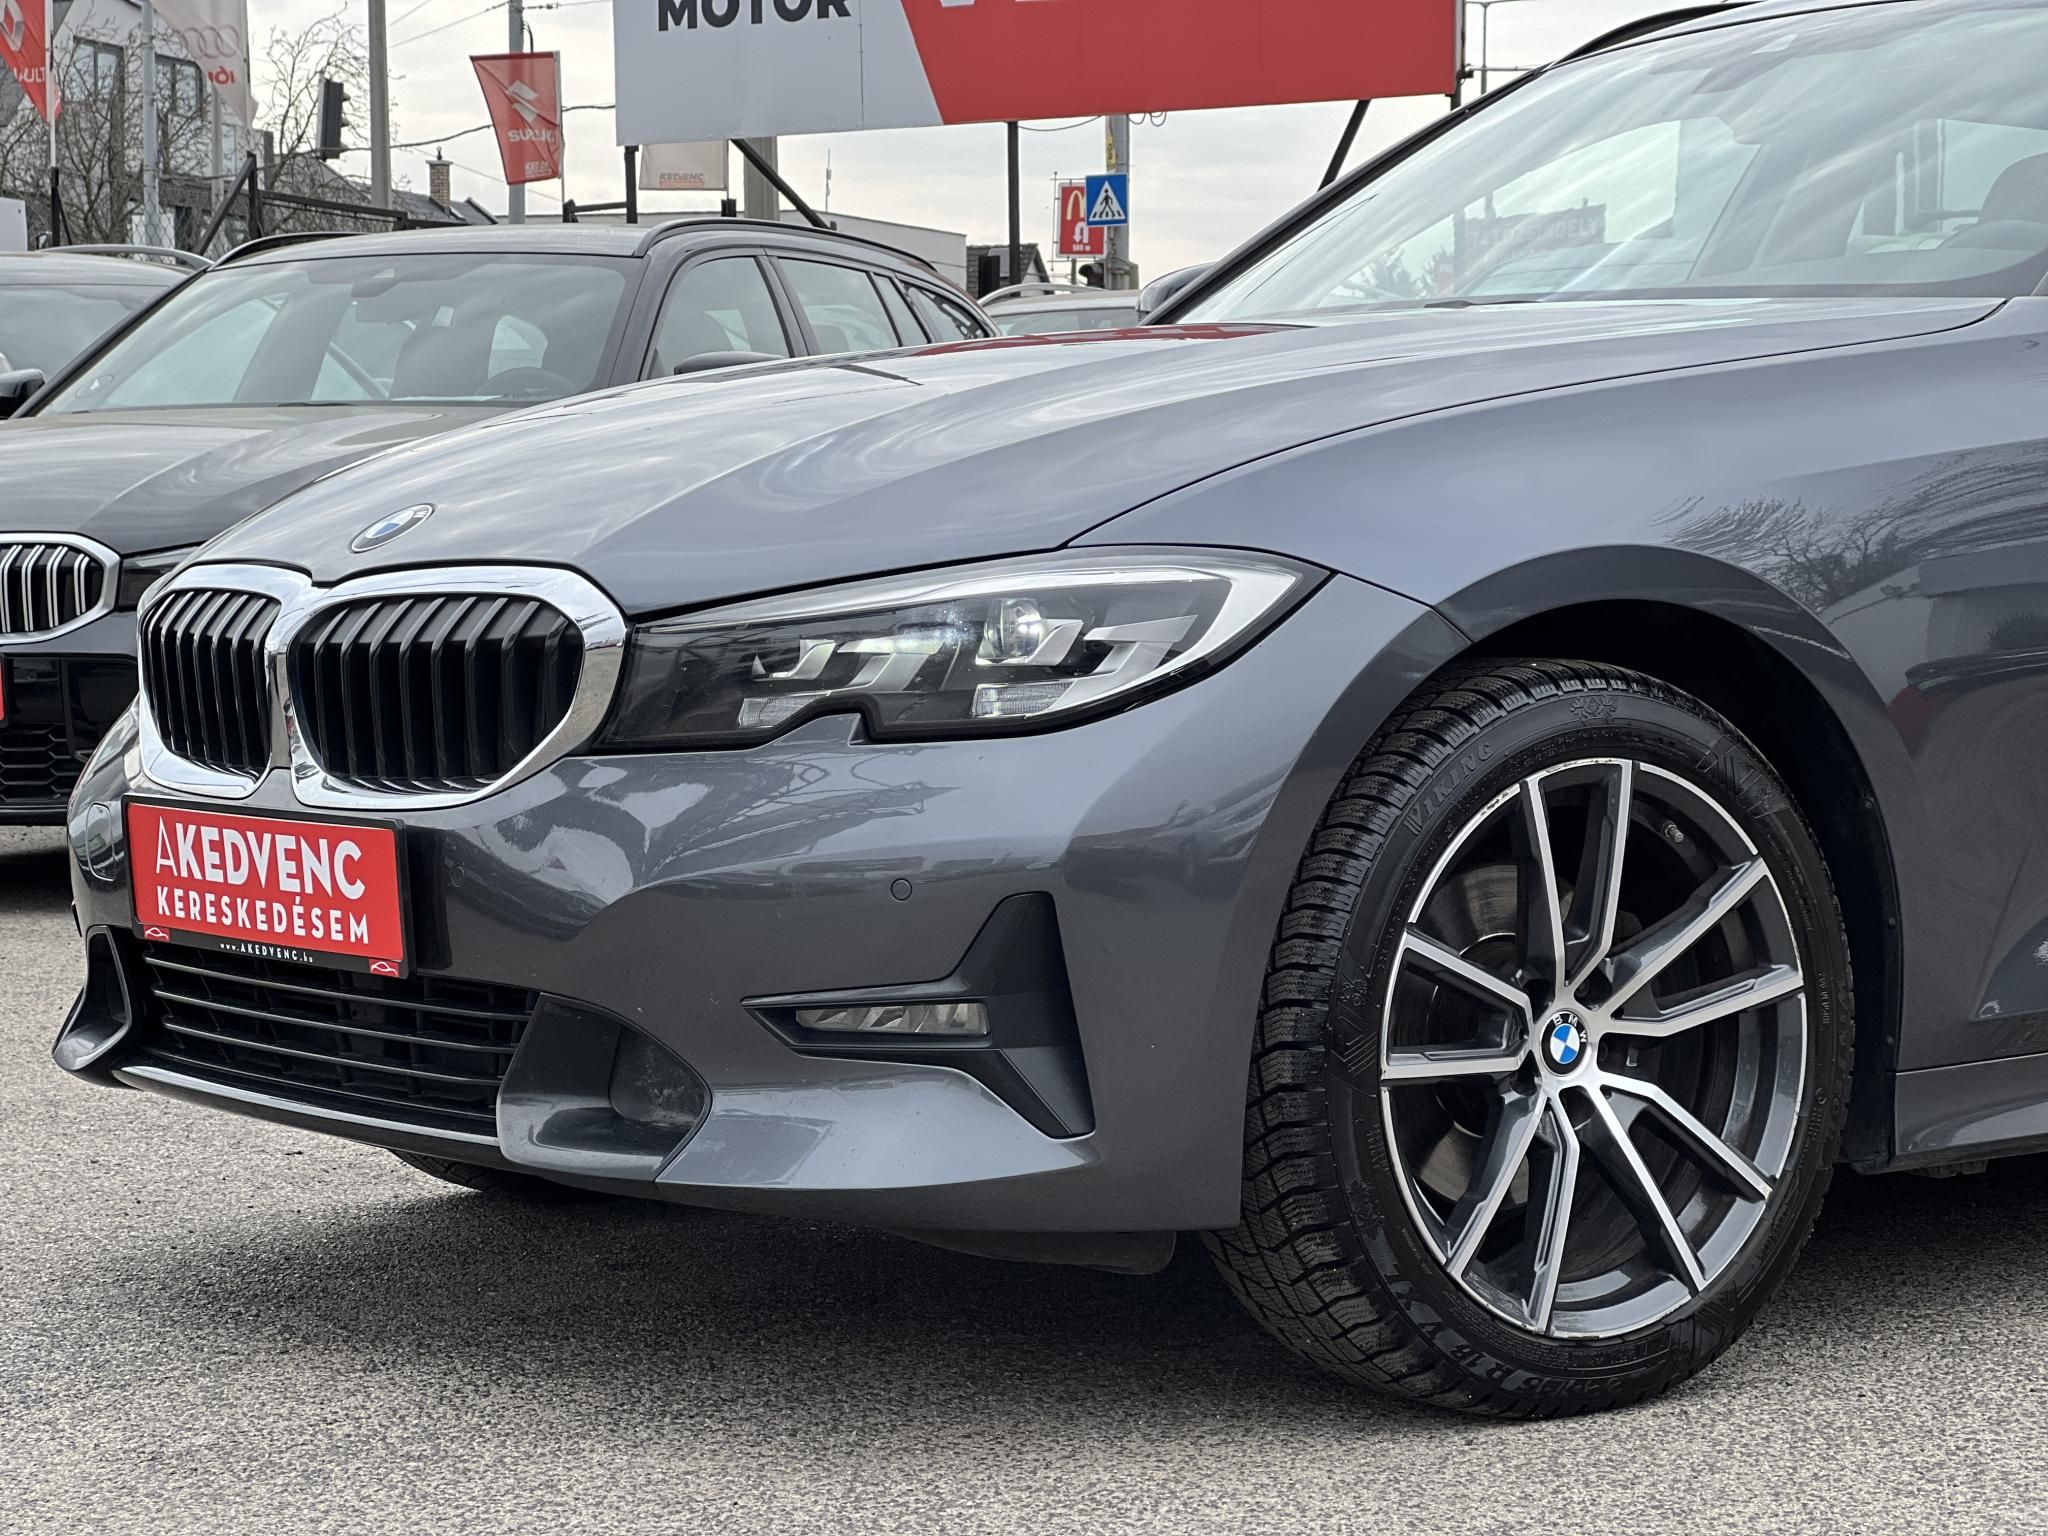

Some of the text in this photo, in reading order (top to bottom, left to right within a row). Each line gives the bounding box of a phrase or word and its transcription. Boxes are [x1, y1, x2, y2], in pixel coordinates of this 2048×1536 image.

[156, 816, 366, 899] AKEDVENC
[156, 885, 369, 945] KERESKEDÉSEM
[1553, 1014, 1587, 1043] BMW
